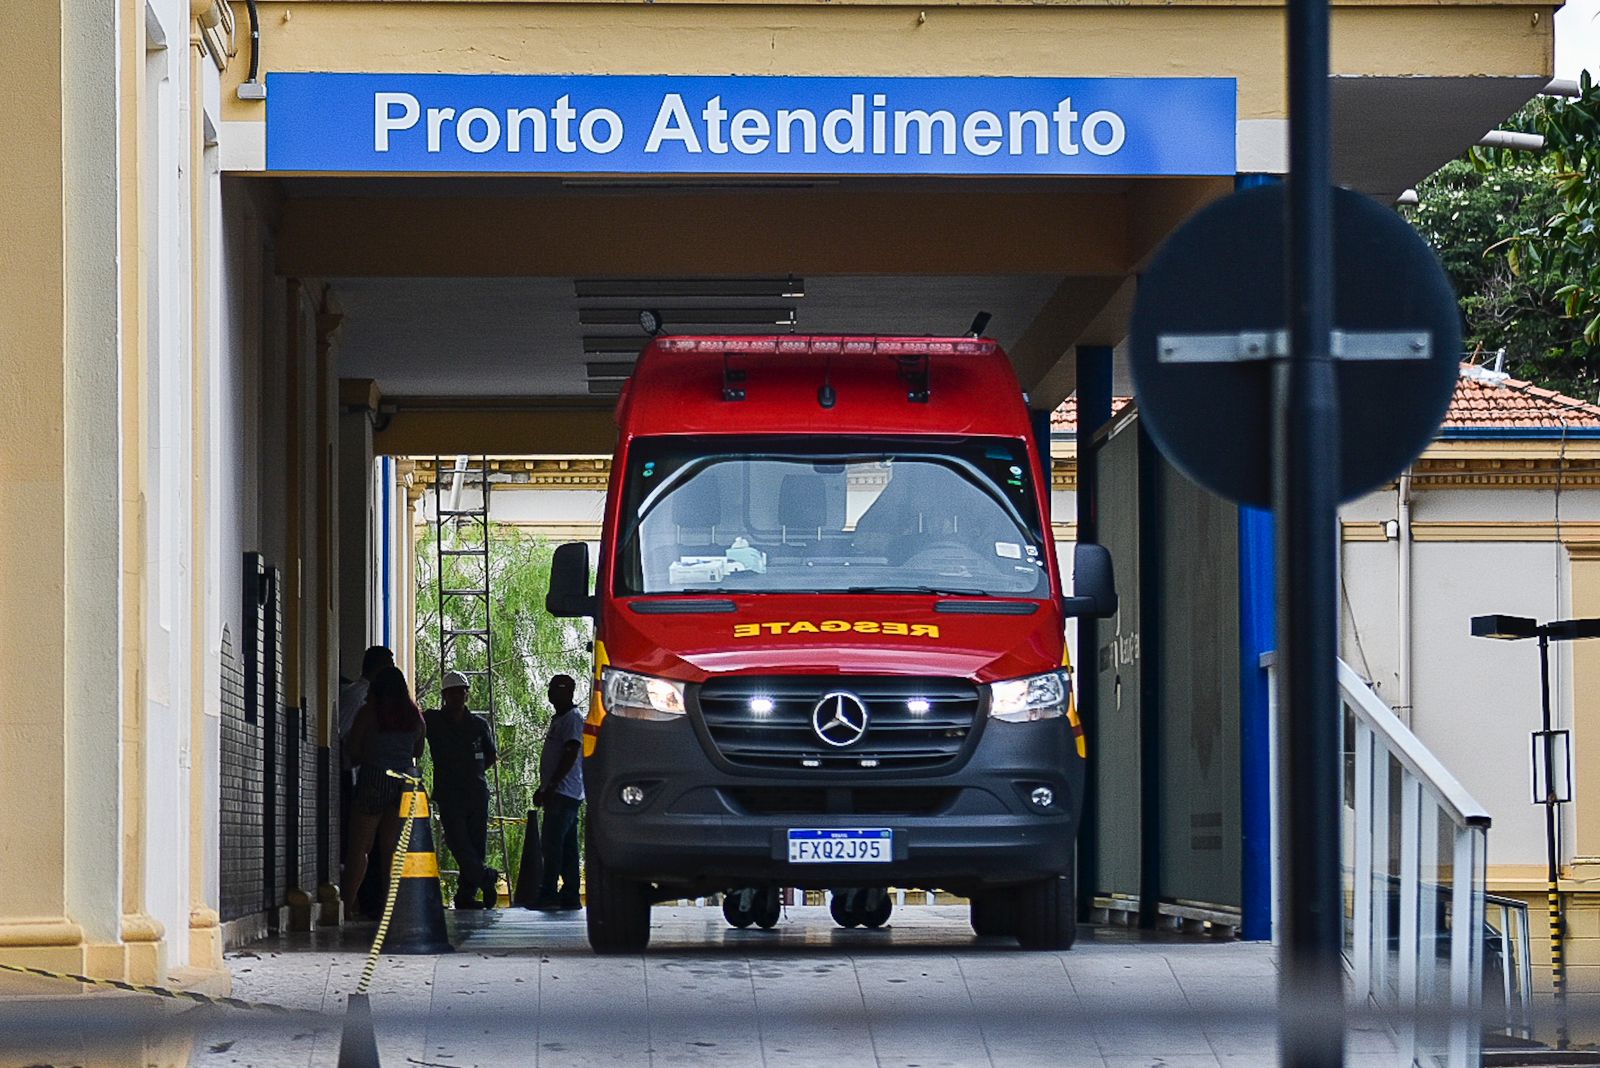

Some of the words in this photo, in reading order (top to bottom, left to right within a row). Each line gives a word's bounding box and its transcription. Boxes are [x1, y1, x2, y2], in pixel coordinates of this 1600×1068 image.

[374, 92, 624, 154] Pronto
[644, 92, 1126, 157] Atendimento
[798, 840, 881, 860] FXQ2J95
